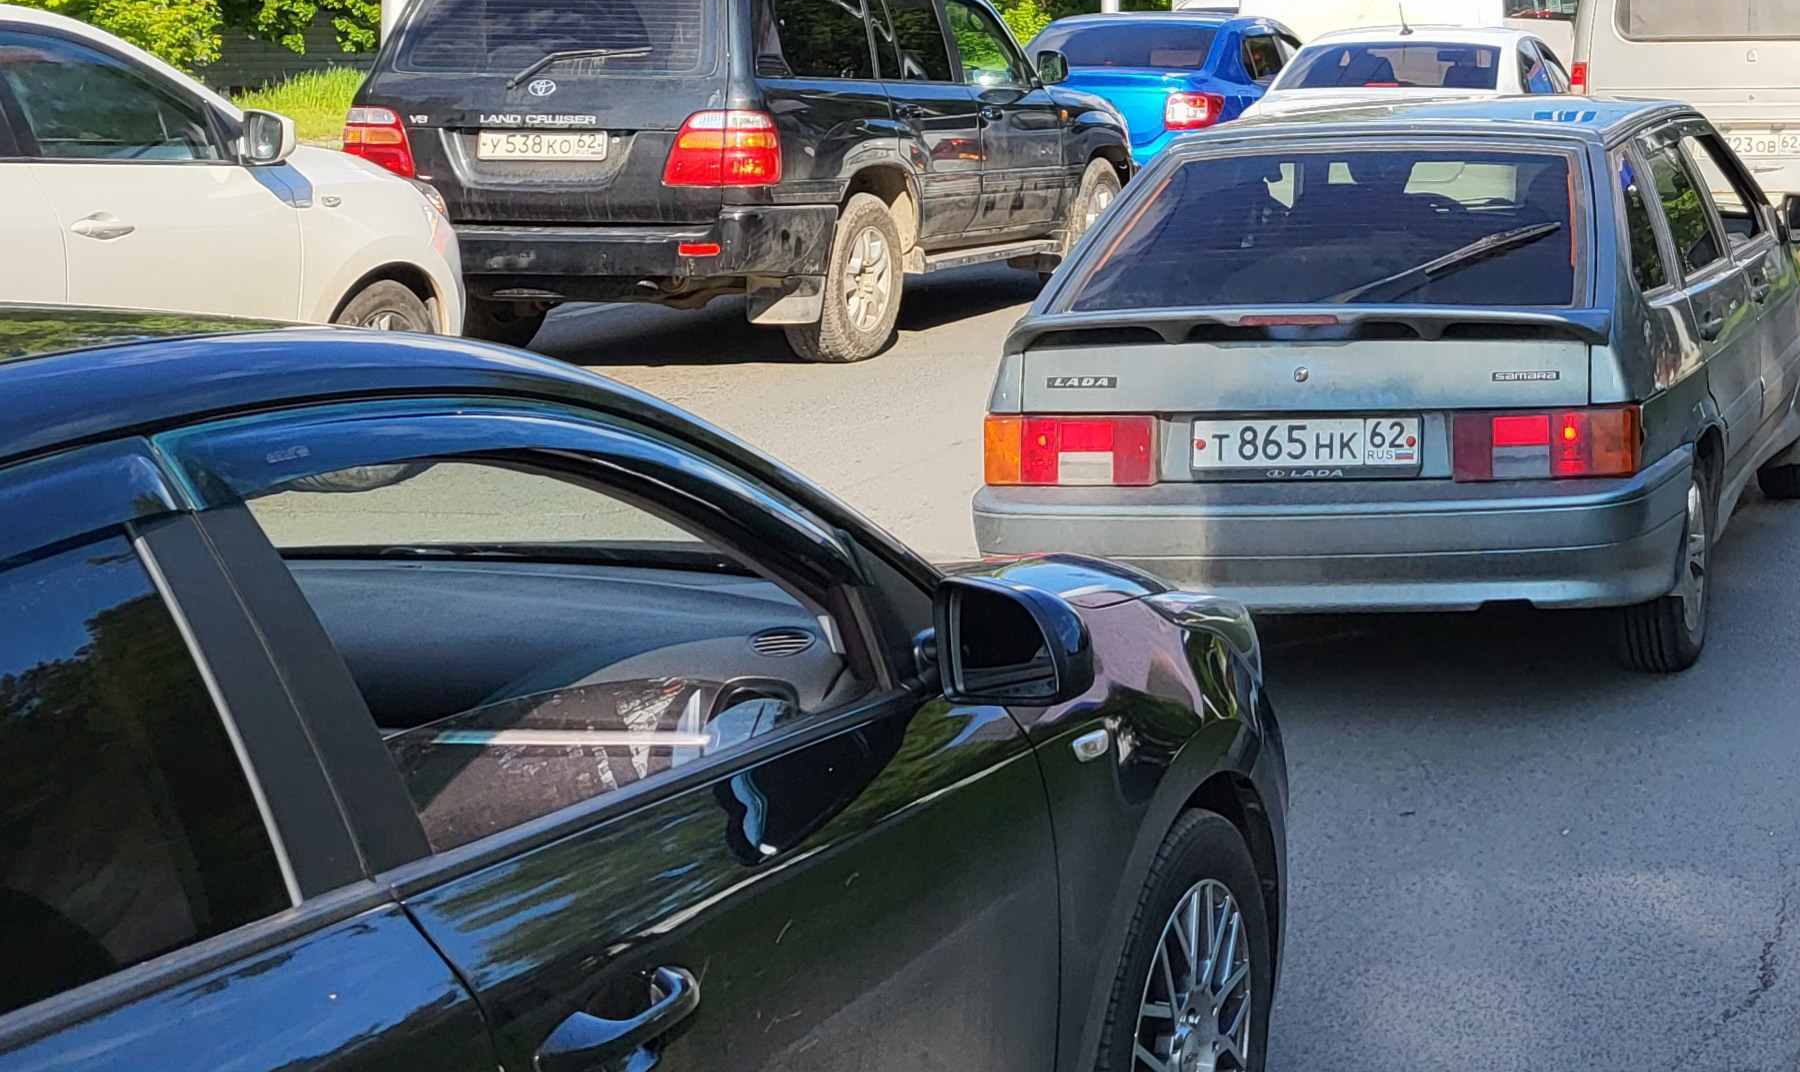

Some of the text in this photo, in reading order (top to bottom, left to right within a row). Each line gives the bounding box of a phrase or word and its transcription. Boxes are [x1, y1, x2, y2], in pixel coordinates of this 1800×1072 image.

[480, 114, 520, 124] LAND
[526, 115, 597, 125] CRUISER
[577, 134, 597, 149] 62
[1054, 377, 1109, 387] LADA
[1369, 420, 1405, 449] 62
[1367, 450, 1393, 460] RUS
[1290, 469, 1344, 478] LADA
